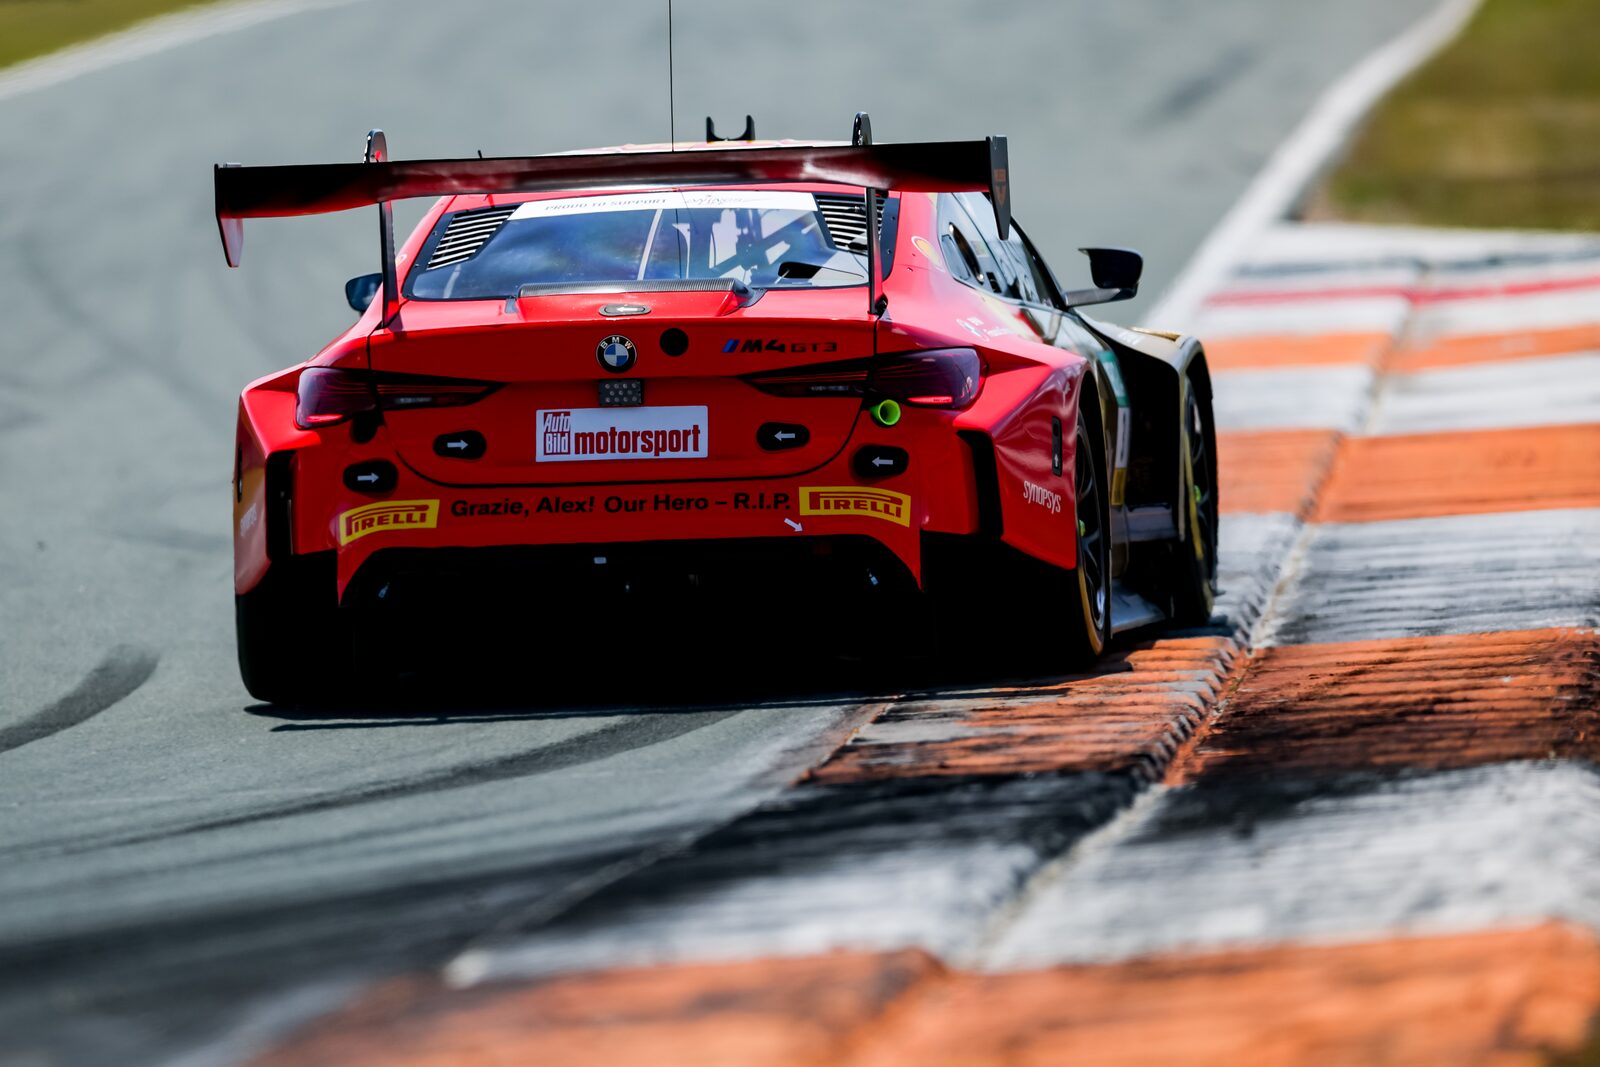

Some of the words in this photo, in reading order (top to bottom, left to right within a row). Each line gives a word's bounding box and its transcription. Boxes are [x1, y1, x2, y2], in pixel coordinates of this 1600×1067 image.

[610, 199, 666, 207] SUPPORT
[600, 336, 633, 350] BMW
[740, 339, 786, 353] M4
[790, 342, 838, 353] GT3
[544, 413, 571, 432] Auto
[545, 433, 569, 454] Bild
[574, 424, 701, 457] motorsport
[451, 498, 529, 518] Grazie,
[536, 496, 595, 513] Alex!
[604, 496, 647, 513] Our
[653, 494, 709, 511] Hero
[733, 492, 792, 511] R.I.P.
[808, 491, 904, 518] PIRELLI
[345, 504, 430, 537] PIRELLI
